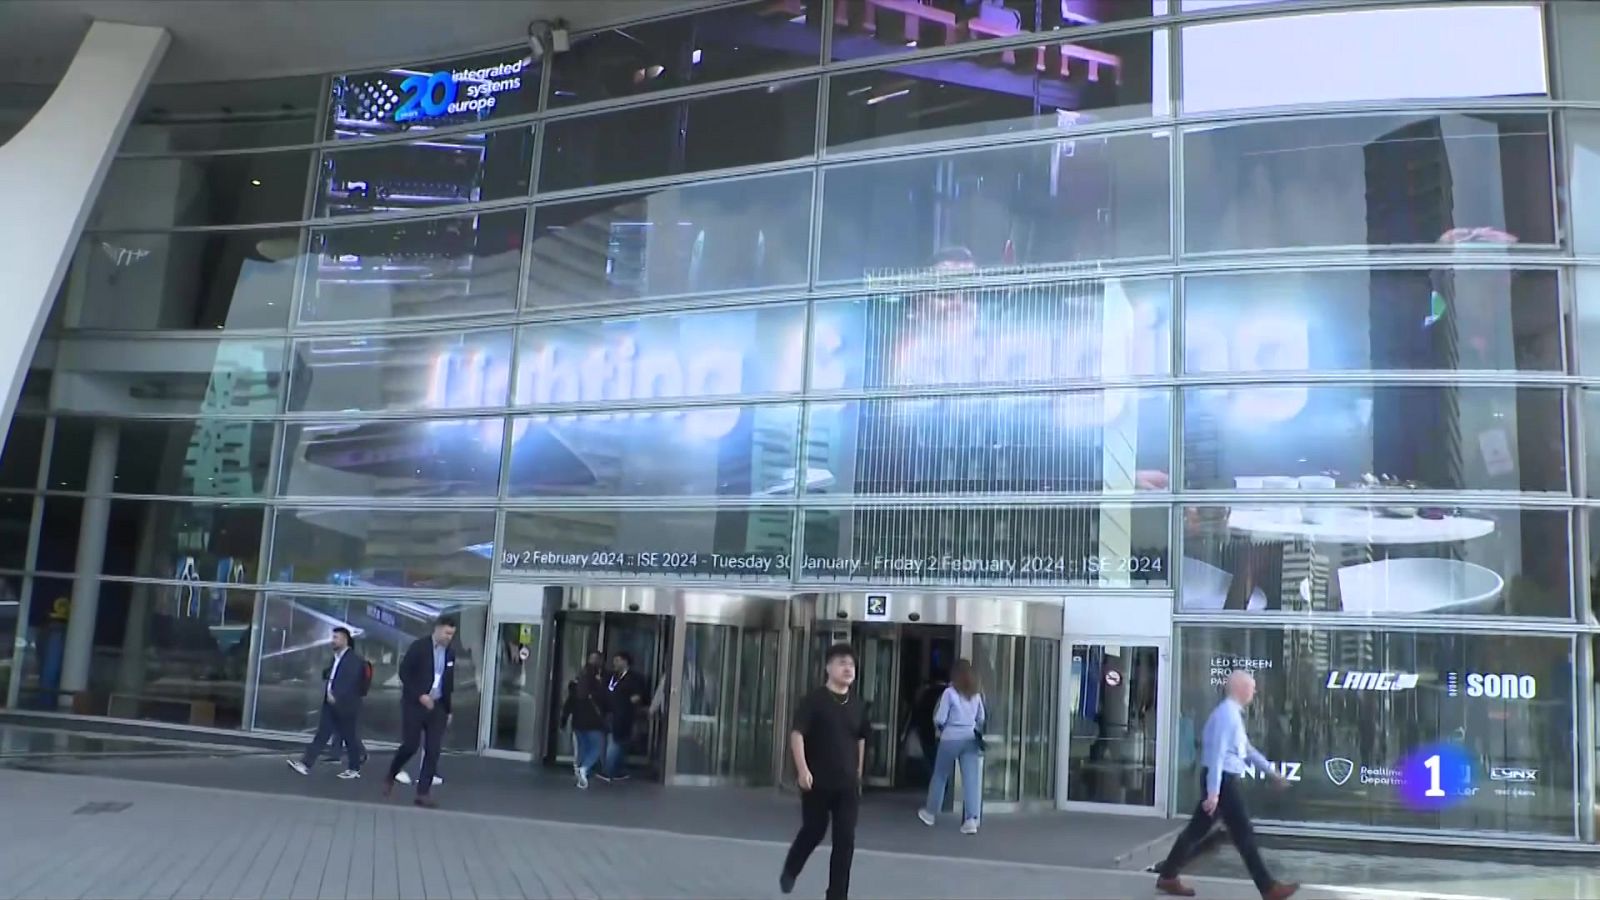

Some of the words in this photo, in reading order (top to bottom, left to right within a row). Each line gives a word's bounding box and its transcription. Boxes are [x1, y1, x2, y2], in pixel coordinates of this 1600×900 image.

[452, 60, 522, 82] integrated
[395, 71, 458, 121] 20
[467, 78, 521, 98] systems
[447, 97, 496, 114] europe
[523, 551, 531, 564] 2
[533, 551, 589, 568] February
[592, 553, 624, 566] 2024
[638, 553, 658, 567] ISE
[662, 553, 697, 567] 2024
[711, 554, 772, 572] Tuesday
[801, 555, 860, 573] January
[874, 555, 923, 573] Friday
[927, 556, 937, 570] 2
[940, 556, 1017, 573] February
[1021, 556, 1065, 572] 2024
[1083, 556, 1112, 572] ISE
[1119, 556, 1162, 572] 2024
[1210, 658, 1230, 667] LED
[1232, 659, 1273, 668] SCREEN
[1327, 671, 1396, 691] LANG
[1466, 673, 1536, 699] SONO
